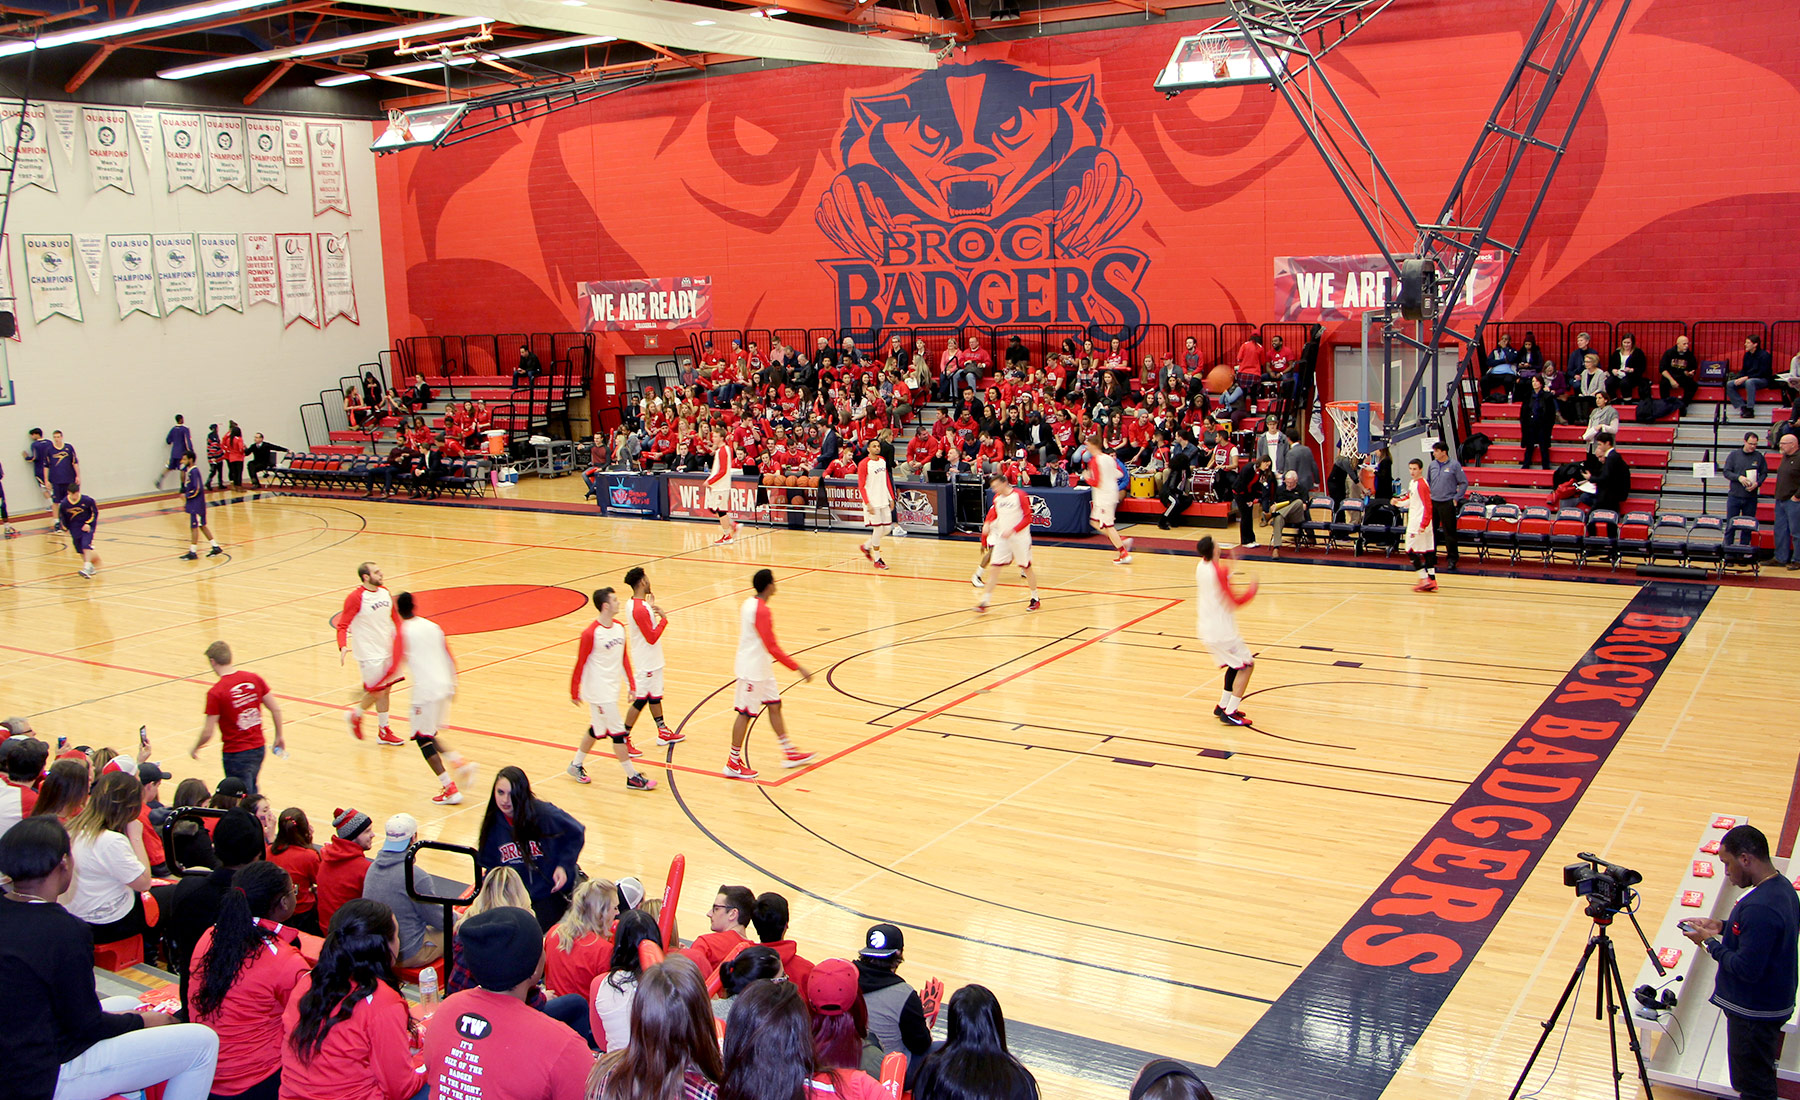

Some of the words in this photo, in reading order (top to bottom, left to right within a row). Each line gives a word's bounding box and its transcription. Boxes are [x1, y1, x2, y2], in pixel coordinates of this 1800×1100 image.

[89, 149, 129, 158] CHAMPIONS
[880, 224, 1081, 266] BROCK
[31, 276, 74, 284] CHAMPIONS
[113, 273, 152, 282] CHAMPIONS
[159, 271, 196, 280] CHAMPIONS
[831, 251, 1141, 343] BADGERS
[1296, 272, 1336, 309] WE
[1342, 271, 1390, 308] ARE
[590, 293, 615, 322] WE
[619, 292, 647, 321] ARE
[649, 289, 698, 320] READY
[679, 485, 700, 509] WE
[847, 489, 854, 499] OF
[1554, 611, 1693, 708] BROCK
[1341, 713, 1621, 975] BADGERS
[460, 1015, 488, 1037] TW
[460, 1040, 474, 1051] IT'S
[450, 1047, 464, 1059] NOT
[465, 1052, 480, 1064] THE
[444, 1055, 458, 1068] SIZE
[457, 1060, 468, 1070] OF
[468, 1064, 484, 1076] THE
[439, 1073, 447, 1083] IN
[447, 1077, 460, 1089] THE
[448, 1067, 473, 1083] BADGER
[439, 1083, 451, 1095] BUT
[451, 1088, 464, 1100] THE
